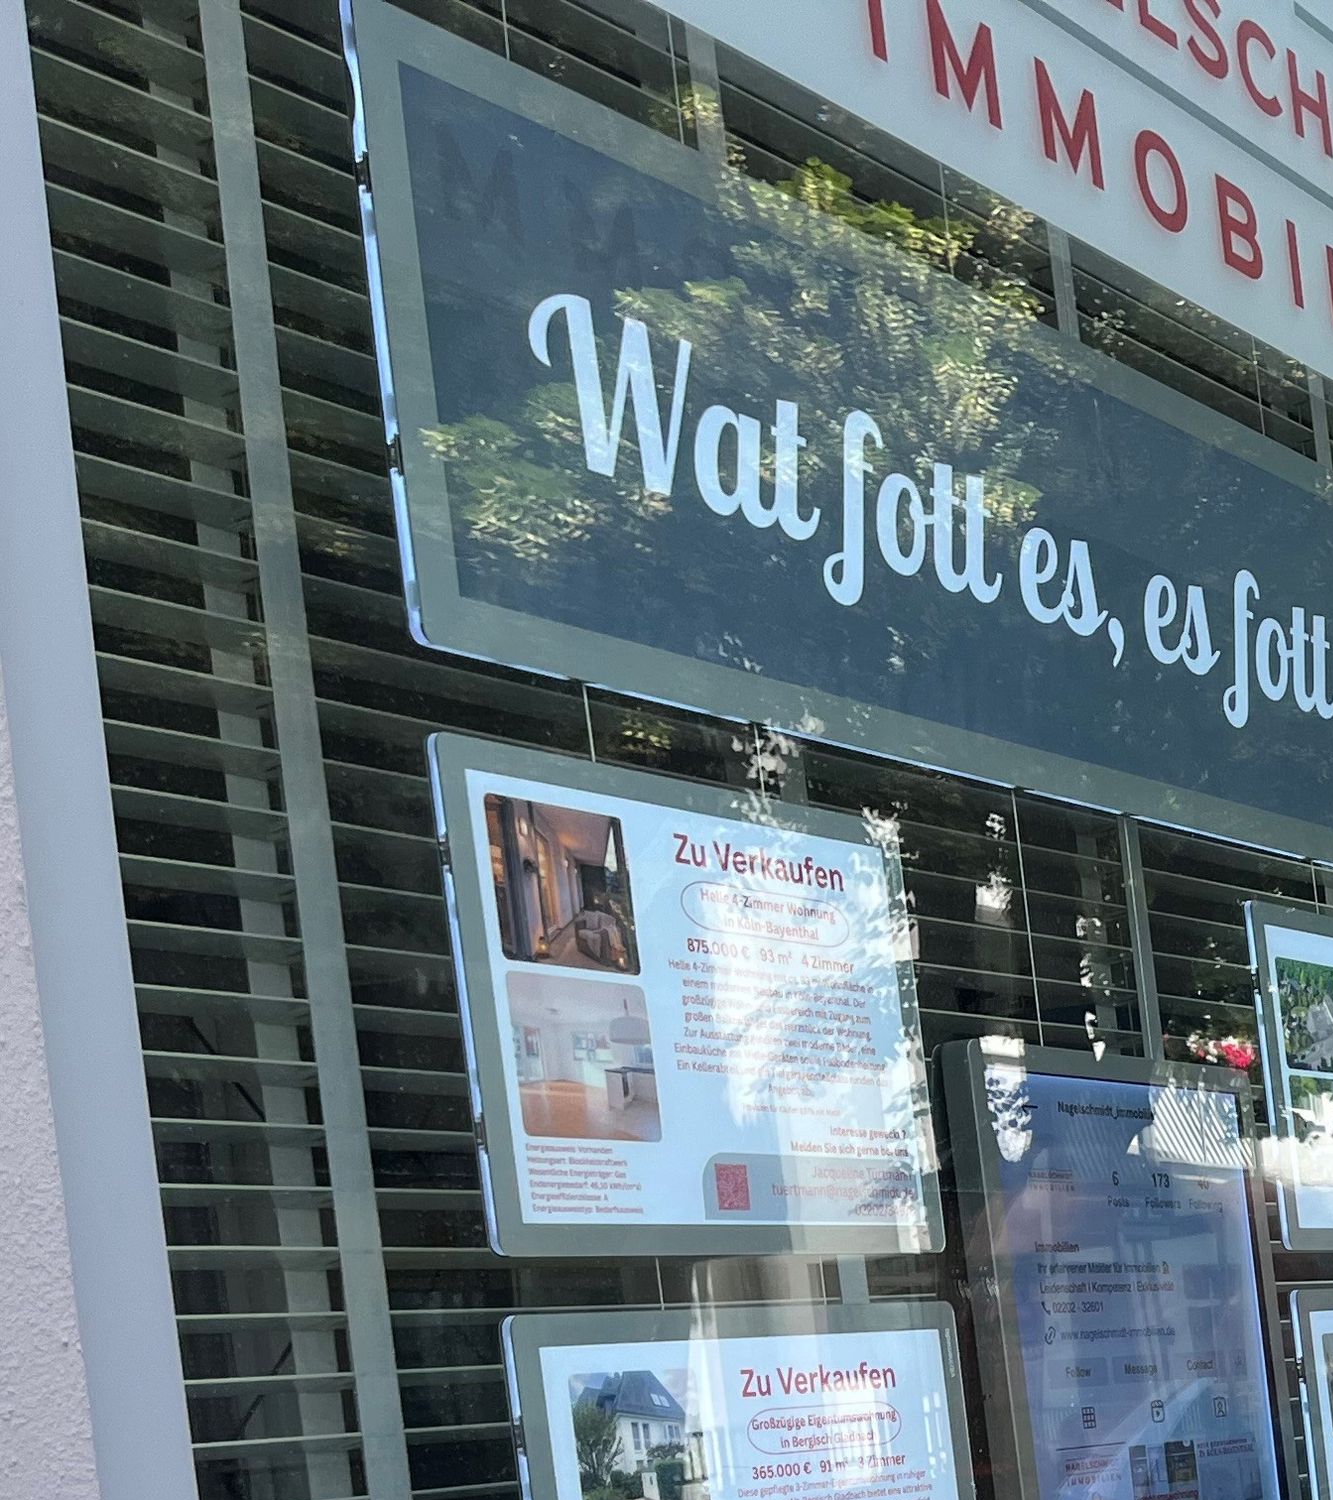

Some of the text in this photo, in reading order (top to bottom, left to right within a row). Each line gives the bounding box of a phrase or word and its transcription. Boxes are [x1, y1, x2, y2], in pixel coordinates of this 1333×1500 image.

[527, 292, 820, 542] Wat
[1016, 520, 1125, 669] es,
[1143, 570, 1222, 677] es
[673, 832, 845, 892] Zu Verkaufen
[787, 901, 836, 925] Wohnung
[736, 916, 819, 942] Köln-Bayenthal
[687, 937, 738, 959] 875.000
[760, 947, 775, 963] 93
[811, 954, 855, 974] Zimmer
[1111, 1170, 1120, 1187] 6
[1151, 1172, 1171, 1189] 173
[1144, 1196, 1182, 1210] Followers
[740, 1361, 897, 1398] Zu Verkaufen
[751, 1414, 806, 1432] Großzügige
[780, 1436, 790, 1449] in
[791, 1432, 831, 1450] Bergisch
[752, 1462, 801, 1480] 365.000
[803, 1461, 812, 1475] €
[819, 1459, 832, 1474] 91
[866, 1454, 906, 1469] Zimmer
